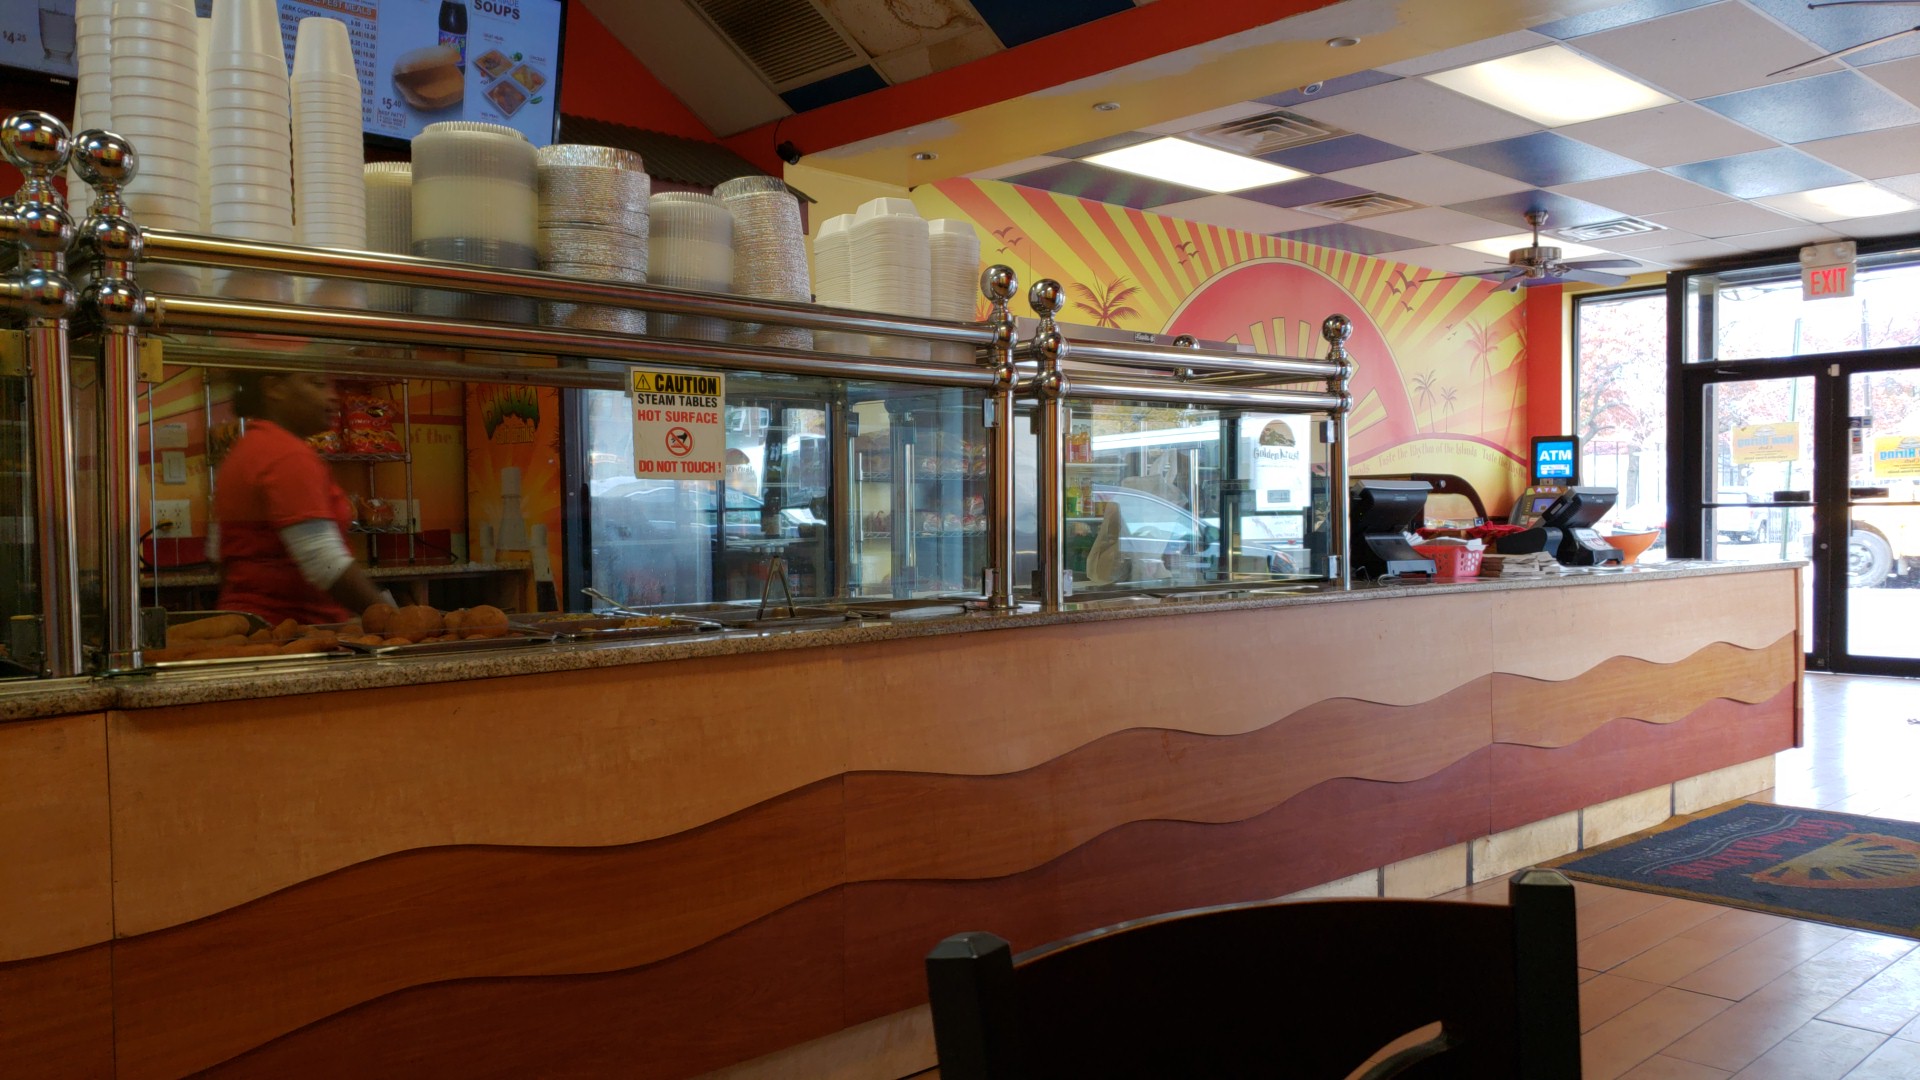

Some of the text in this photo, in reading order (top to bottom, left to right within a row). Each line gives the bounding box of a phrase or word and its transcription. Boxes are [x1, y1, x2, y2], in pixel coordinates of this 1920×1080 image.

[281, 3, 297, 12] JERK
[474, 0, 520, 20] SOUPS
[1810, 267, 1848, 296] EXIT
[654, 374, 717, 395] CAUTION
[637, 393, 718, 408] STEAM TABLES
[637, 409, 718, 424] HOT SURFACE
[1253, 447, 1300, 460] Golden Krust
[1378, 454, 1396, 468] Taste
[1398, 448, 1408, 460] the
[1410, 443, 1434, 459] Rhythm
[1435, 443, 1444, 453] of
[1444, 443, 1455, 454] the
[1539, 450, 1572, 462] ATM
[638, 460, 654, 473] DO
[656, 460, 678, 473] NOT
